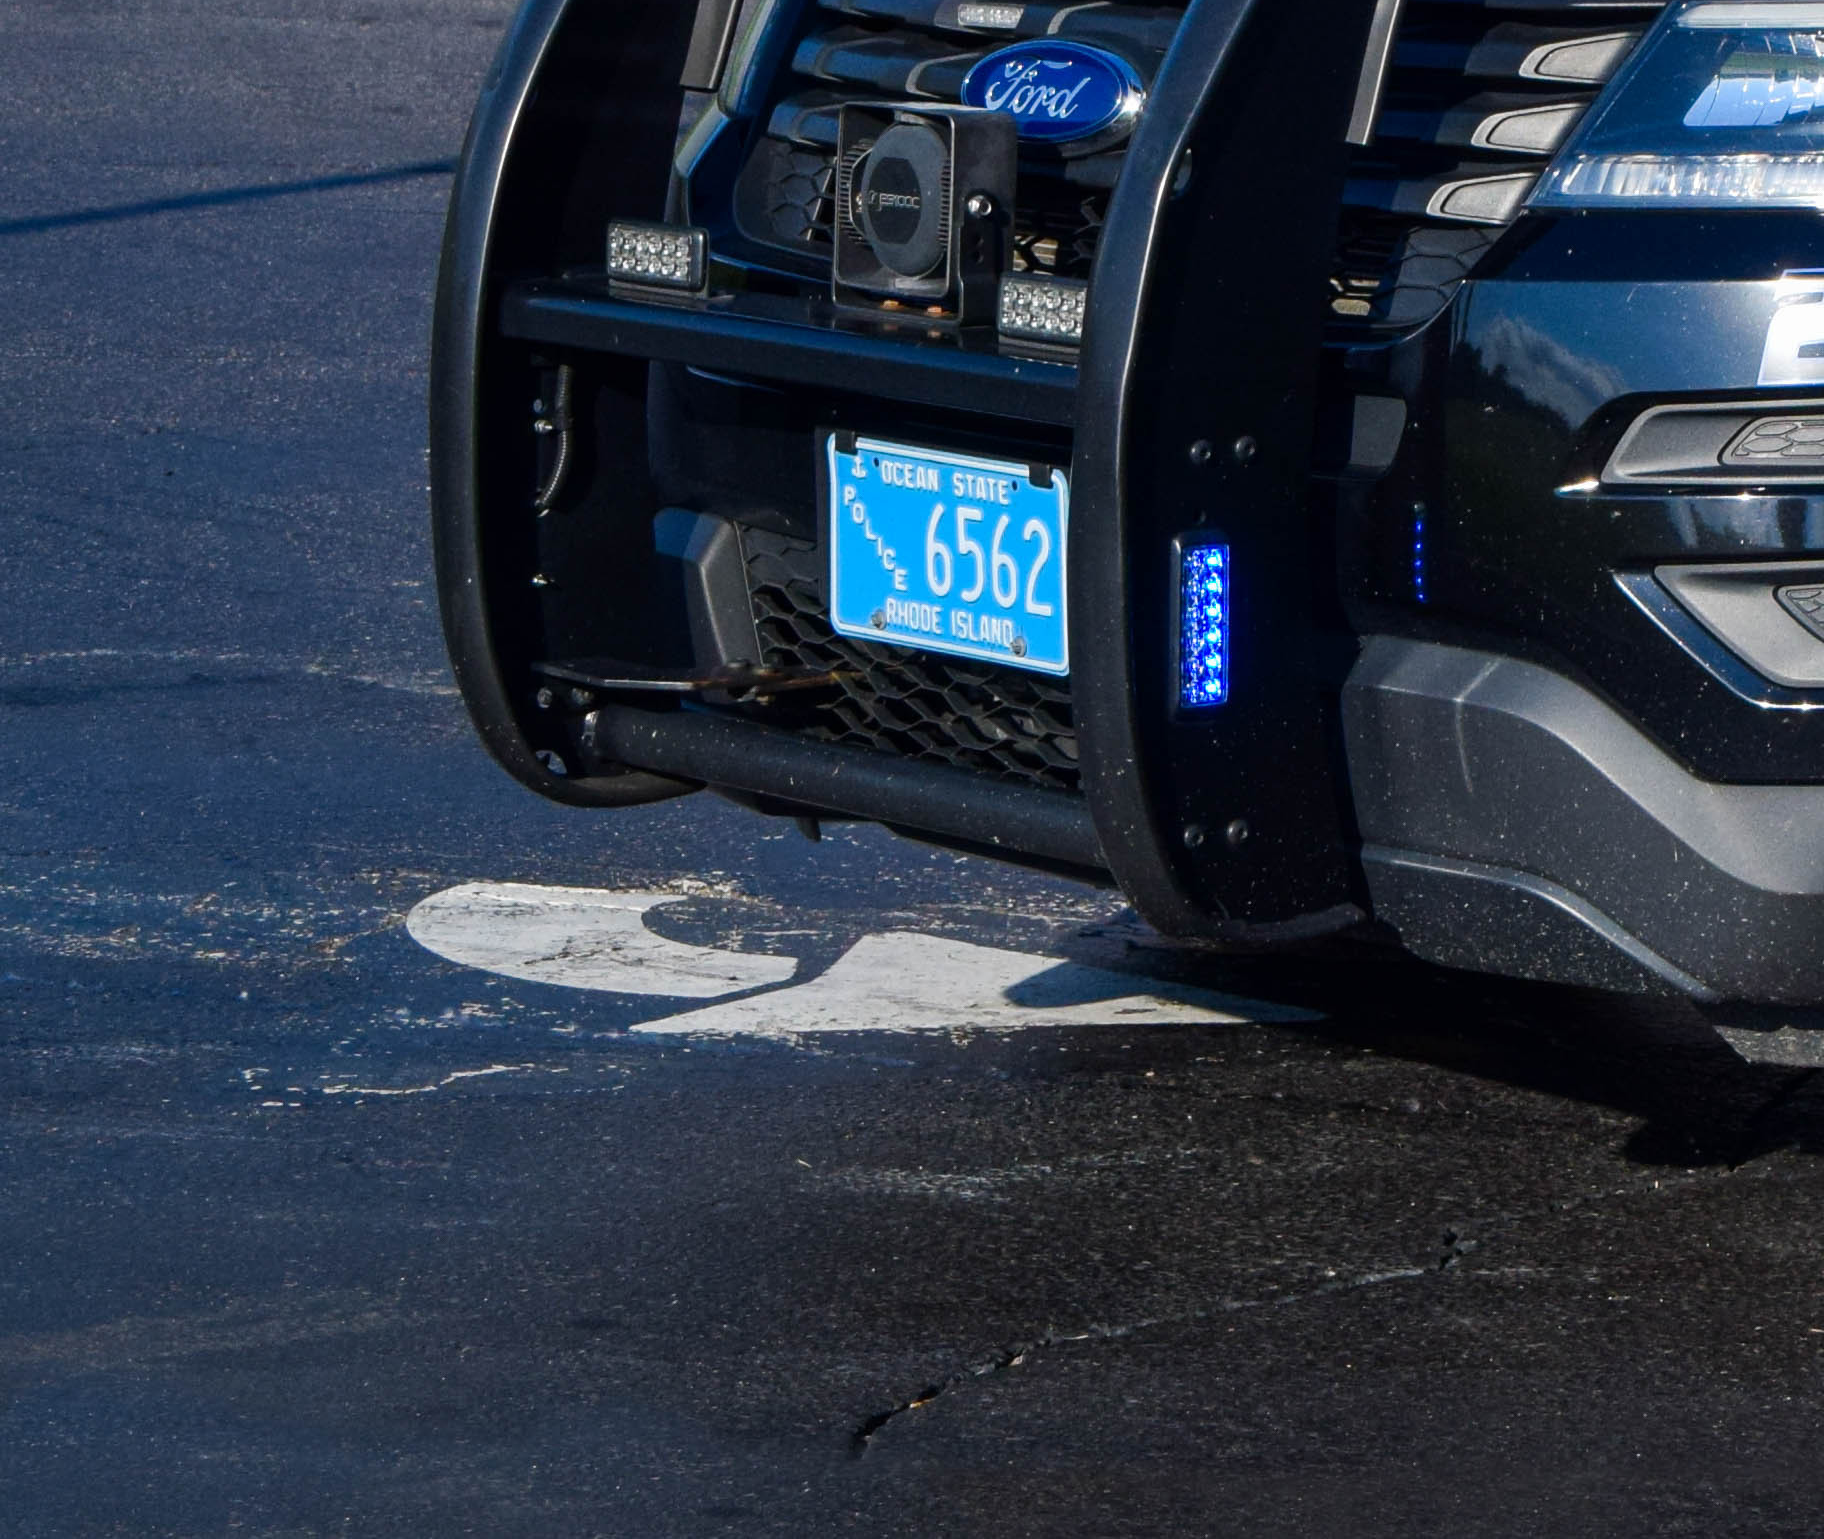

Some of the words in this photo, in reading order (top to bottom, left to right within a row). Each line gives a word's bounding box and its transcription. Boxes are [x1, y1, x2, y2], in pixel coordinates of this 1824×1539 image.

[985, 59, 1092, 119] Ford
[880, 461, 941, 493] OCEAN
[953, 474, 1011, 505] STATE
[843, 485, 908, 592] POLICE
[924, 502, 1054, 617] 6562
[886, 598, 943, 635] RHODE
[951, 611, 1016, 649] ISLAND
